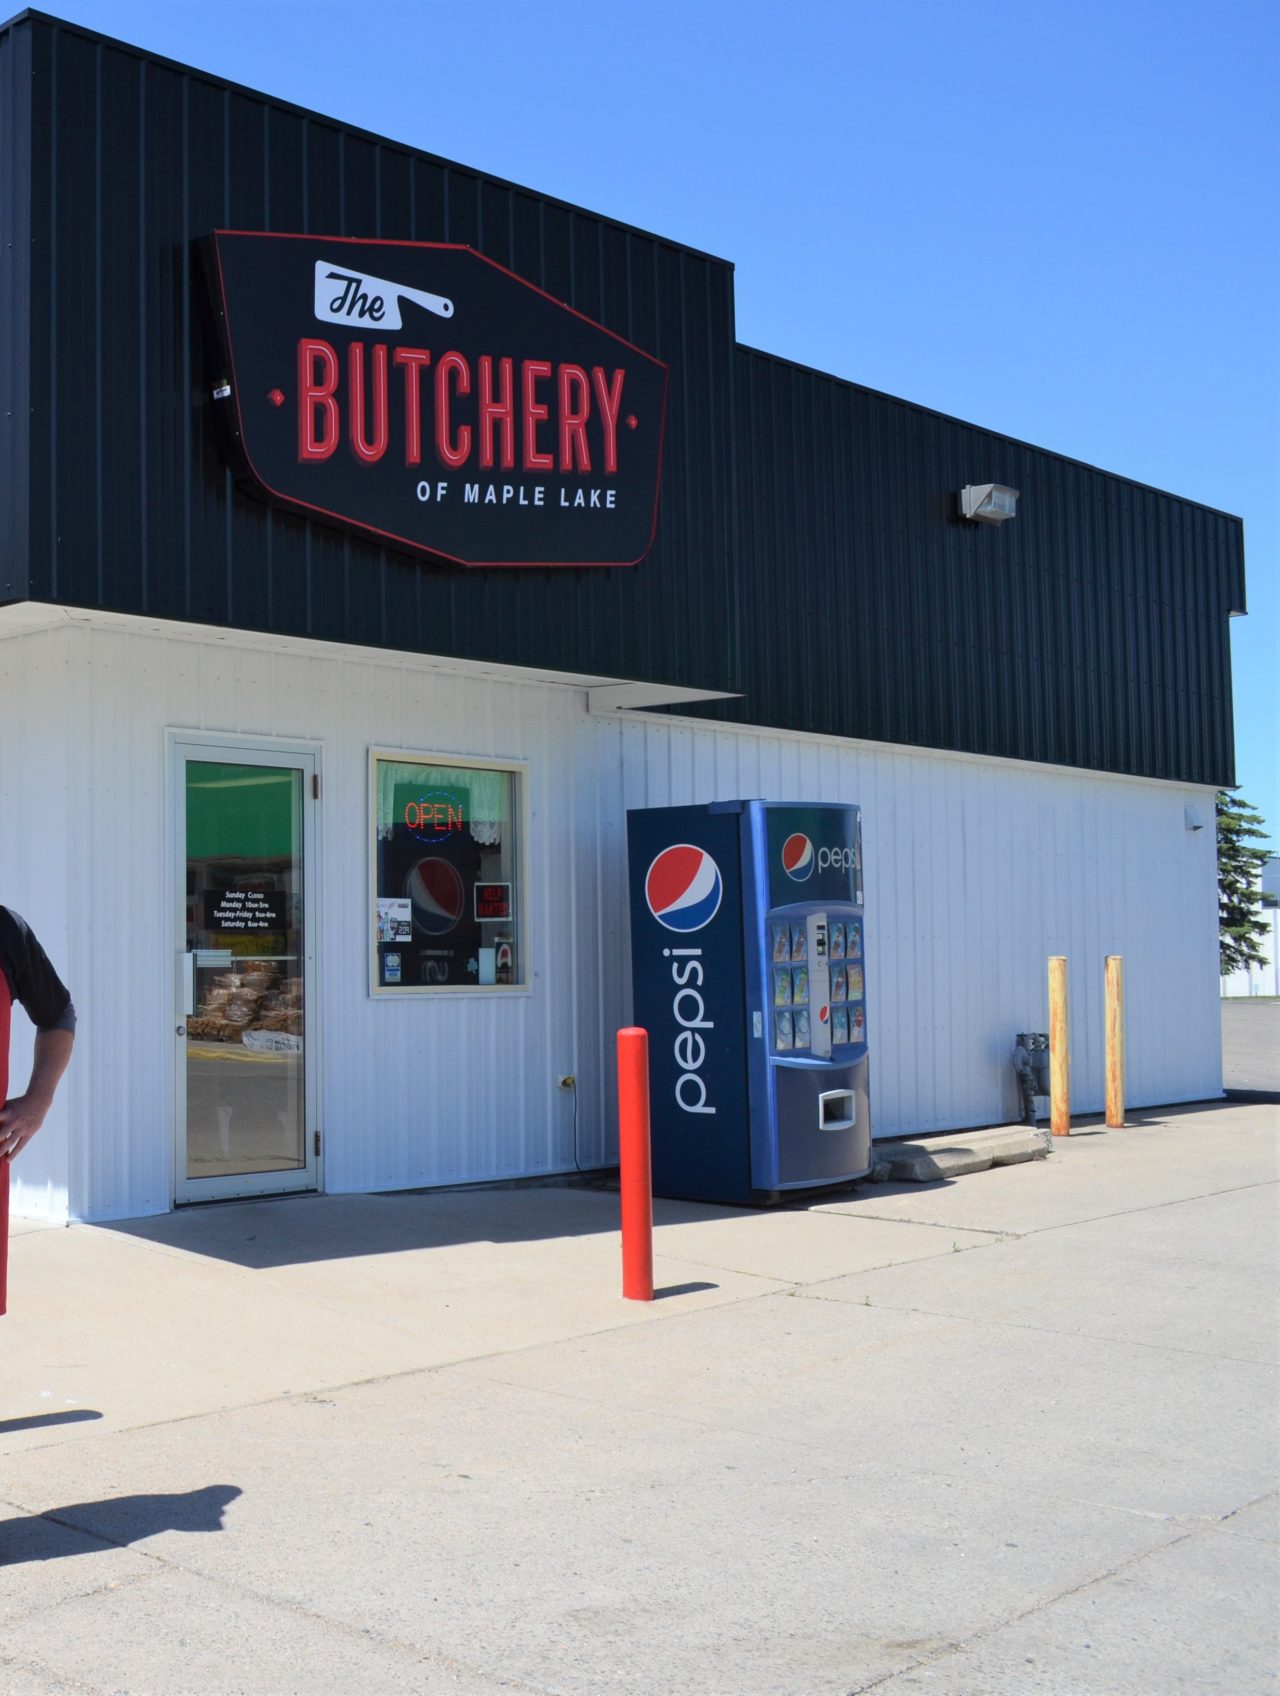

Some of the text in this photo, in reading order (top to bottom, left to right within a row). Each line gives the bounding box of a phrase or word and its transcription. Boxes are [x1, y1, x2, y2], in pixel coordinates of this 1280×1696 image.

[325, 271, 386, 322] The
[297, 337, 626, 475] BUTCHERY
[416, 480, 617, 509] OF MAPLE LAKE
[404, 802, 463, 831] OPEN
[220, 901, 242, 909] Monday
[225, 891, 245, 899] Sunday
[214, 911, 252, 919] Tuesday-Friday
[221, 920, 245, 928] Saturday
[662, 948, 716, 1114] pepsi
